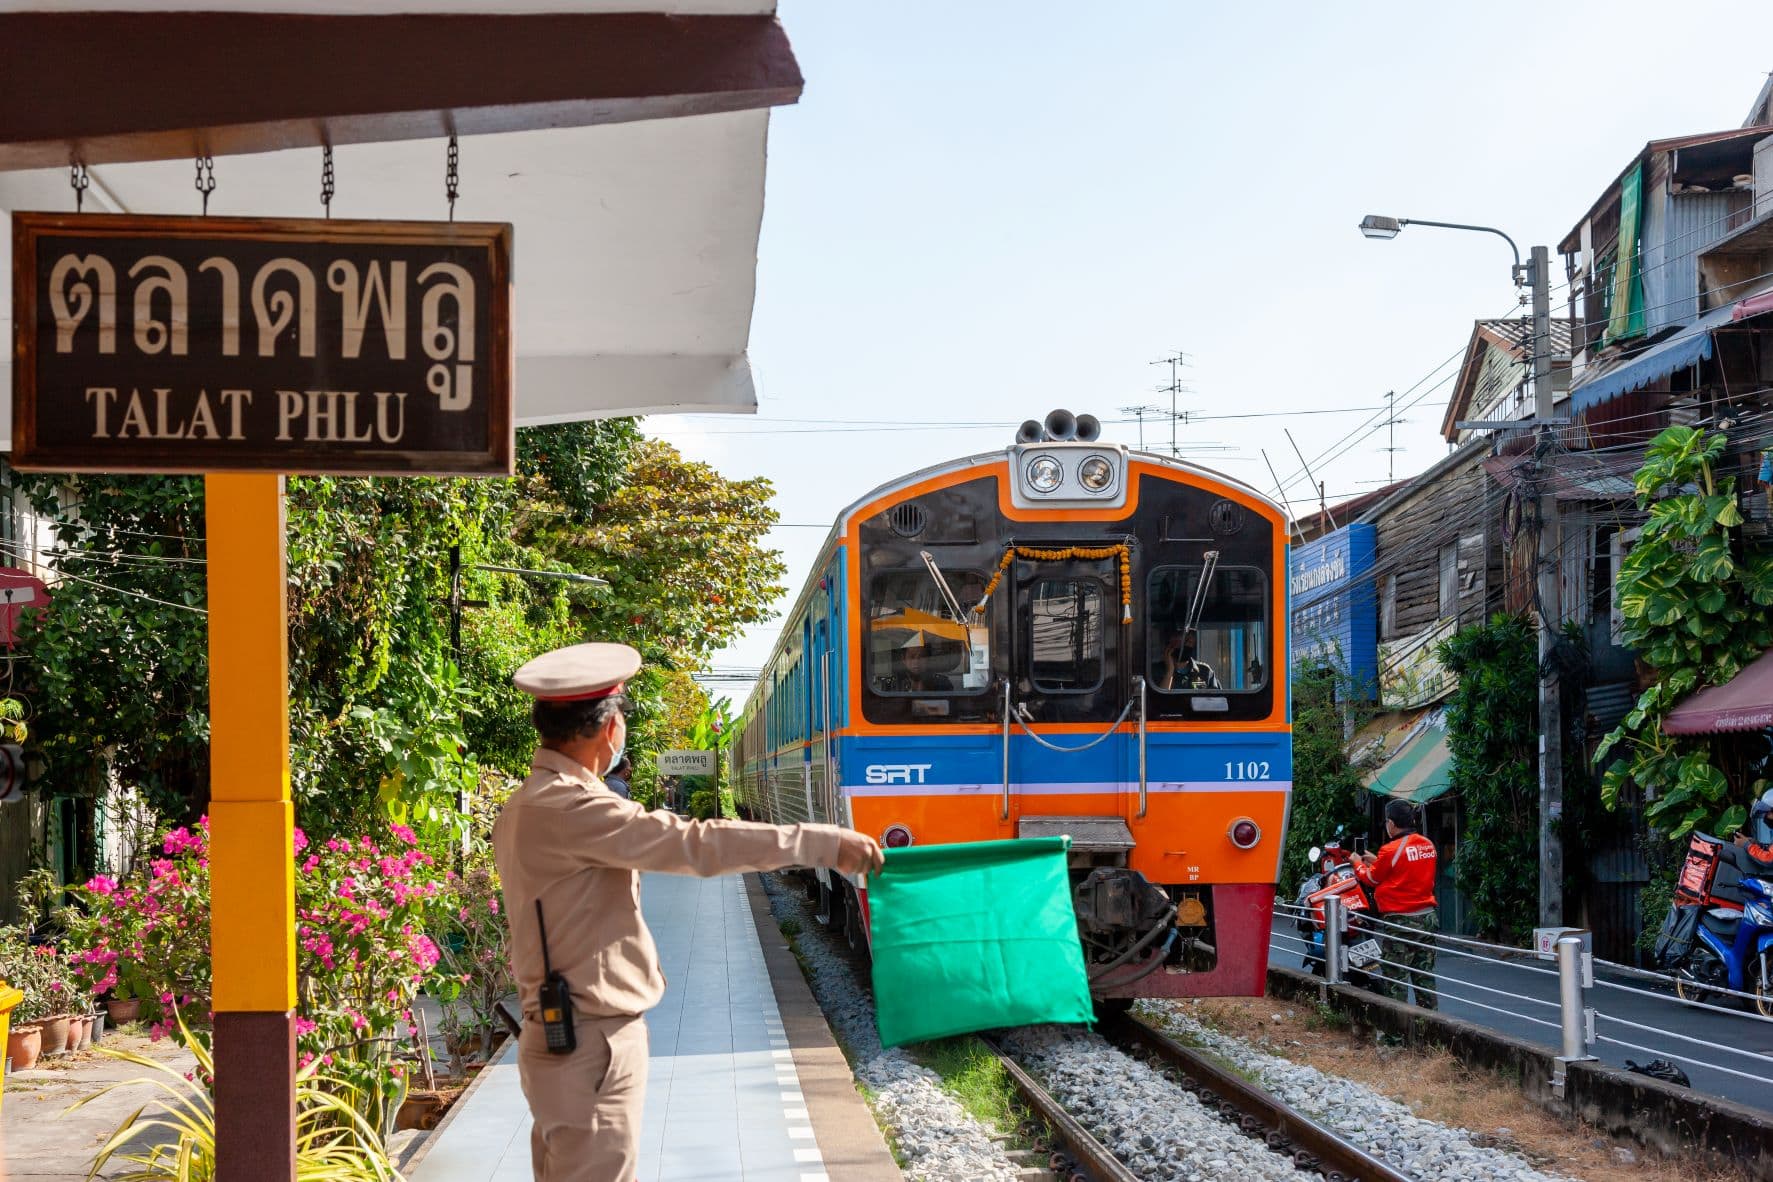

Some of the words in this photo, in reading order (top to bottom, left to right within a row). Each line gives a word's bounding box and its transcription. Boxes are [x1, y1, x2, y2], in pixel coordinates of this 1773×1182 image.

[49, 253, 476, 412] ตลาดพลู
[85, 387, 252, 440] TALAT
[275, 390, 408, 444] PHLU
[664, 755, 707, 768] ตลาดพลู
[1224, 761, 1271, 781] 1102
[865, 763, 932, 784] SRT
[1418, 849, 1435, 859] Food
